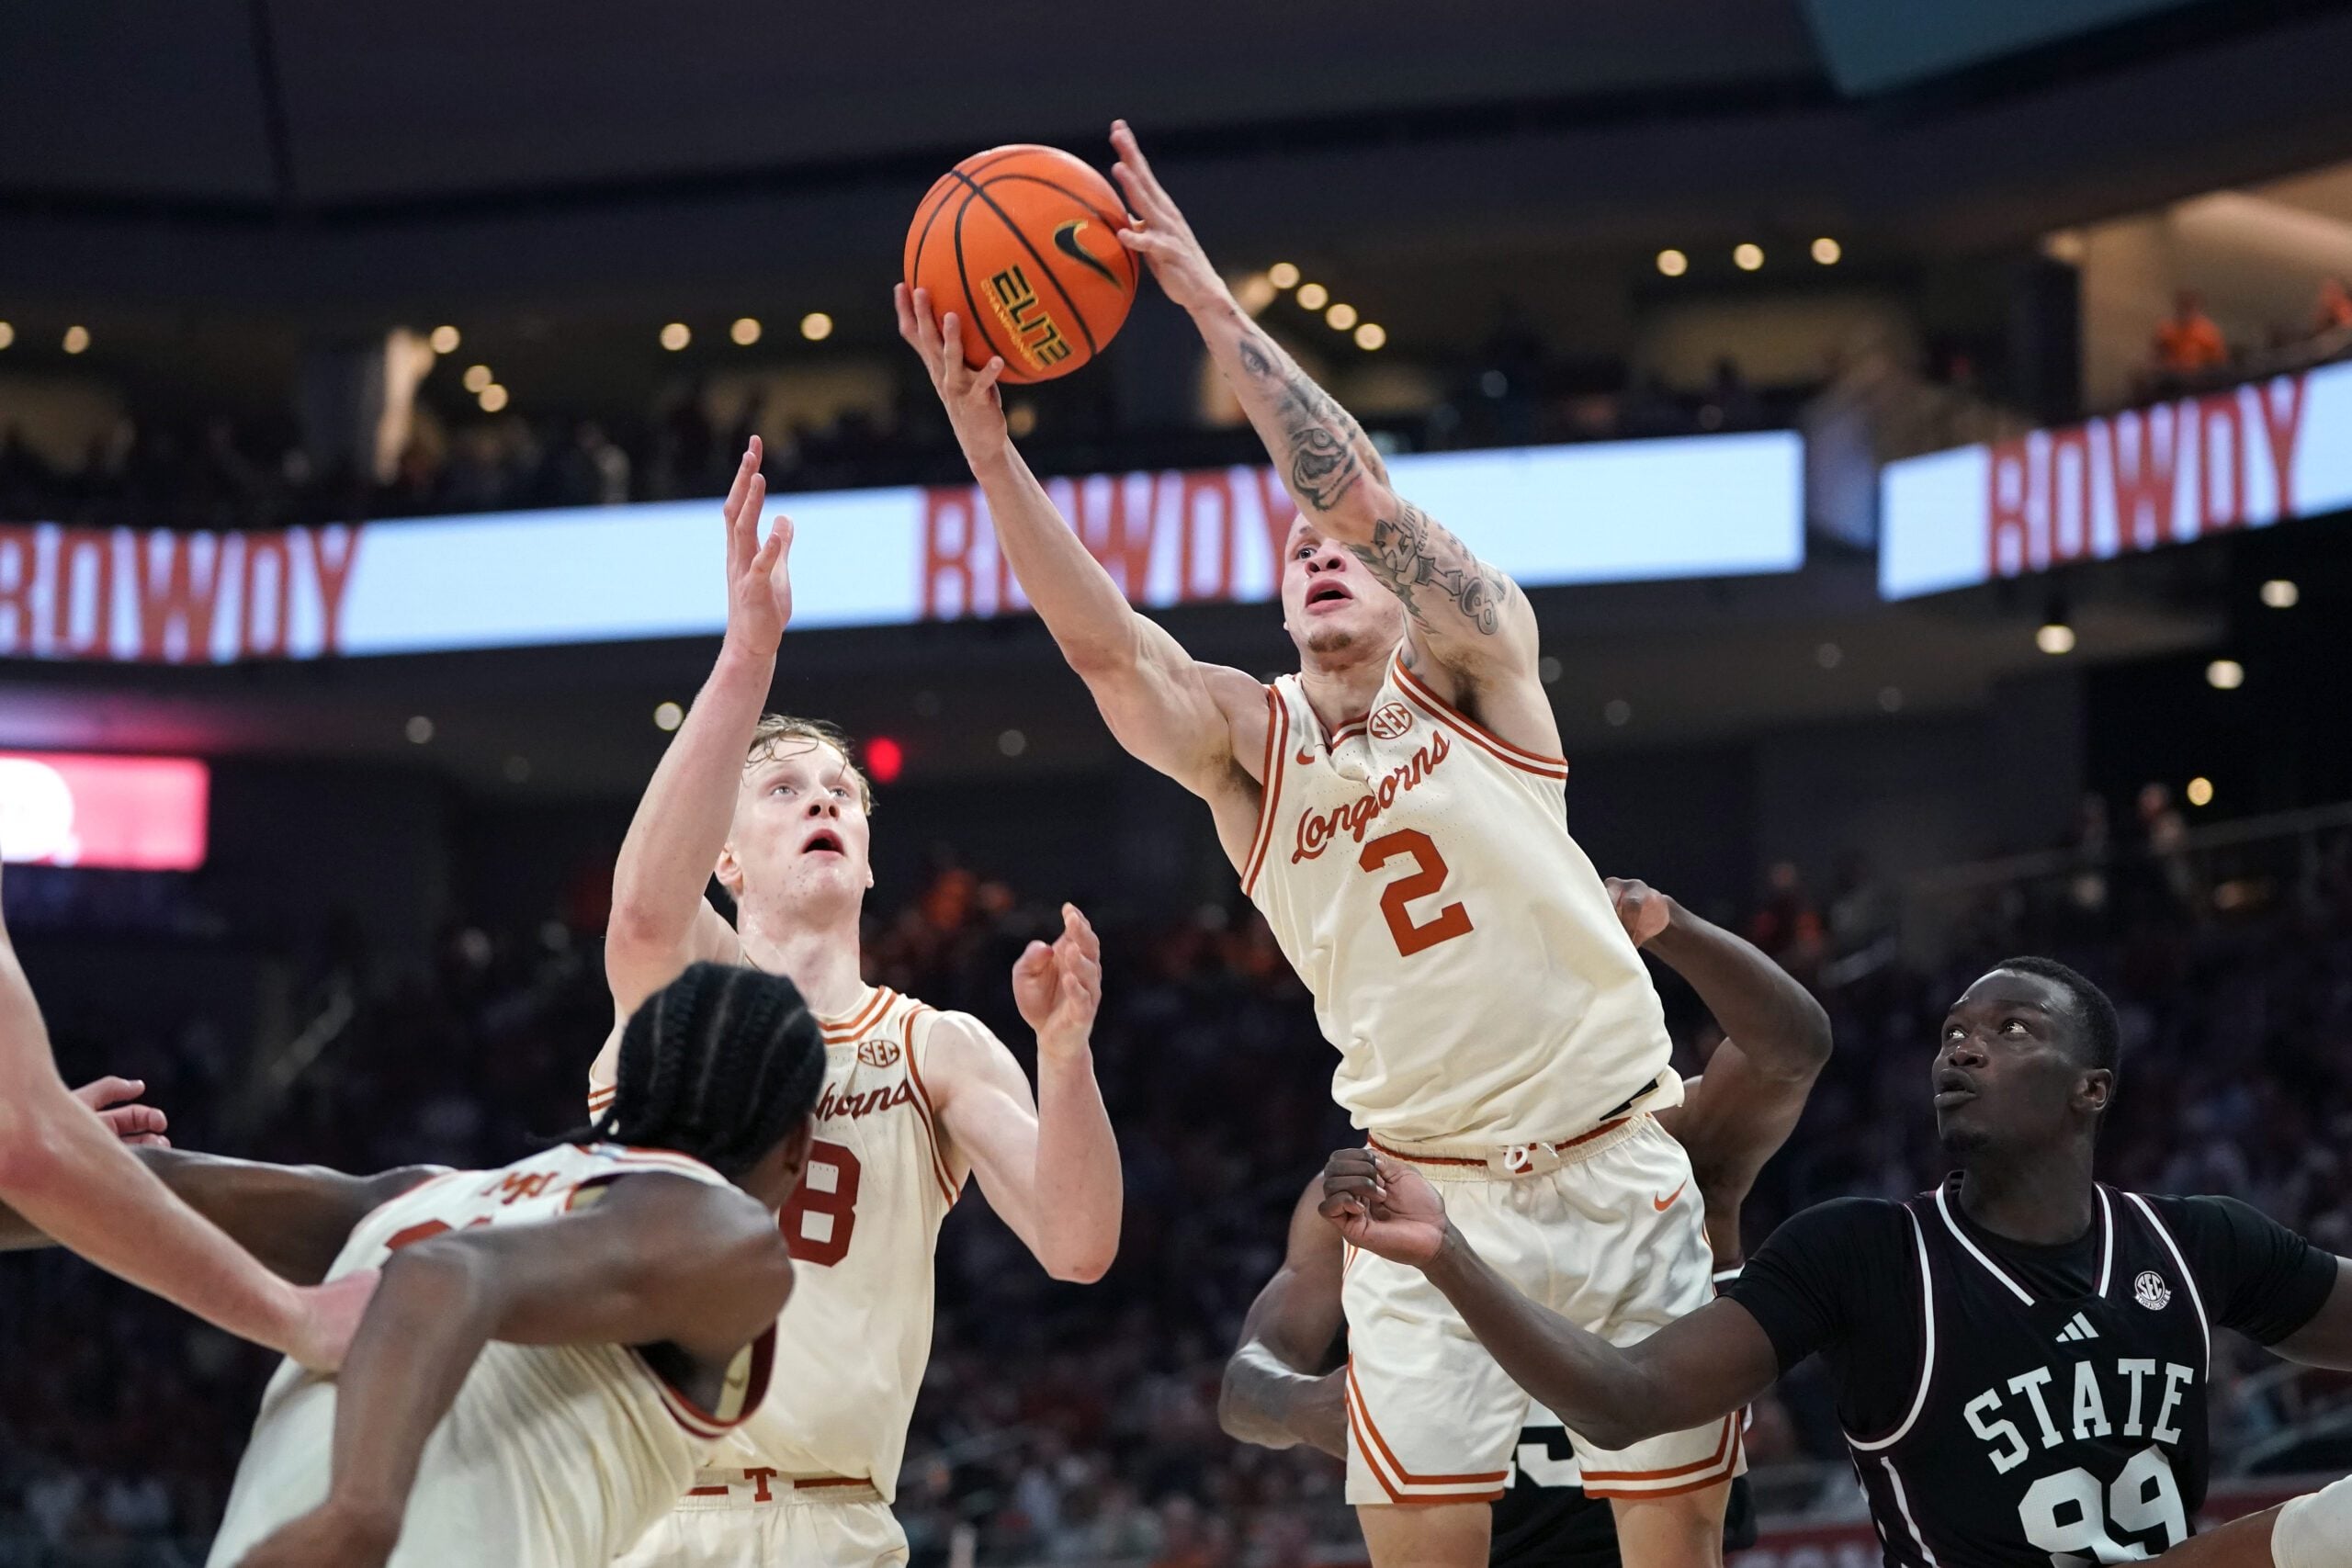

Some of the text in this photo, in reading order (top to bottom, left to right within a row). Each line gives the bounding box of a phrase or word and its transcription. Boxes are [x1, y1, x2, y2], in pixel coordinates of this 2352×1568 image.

[991, 265, 1071, 367] ELITE
[1989, 374, 2310, 581] ROWDY
[1370, 703, 1411, 739] SEC
[1358, 829, 1474, 957] 2
[859, 1040, 899, 1067] SEC
[778, 1137, 861, 1268] 8
[2135, 1272, 2164, 1301] SEC
[1963, 1358, 2194, 1475] STATE
[743, 1467, 777, 1502] T
[2018, 1444, 2188, 1566] 99
